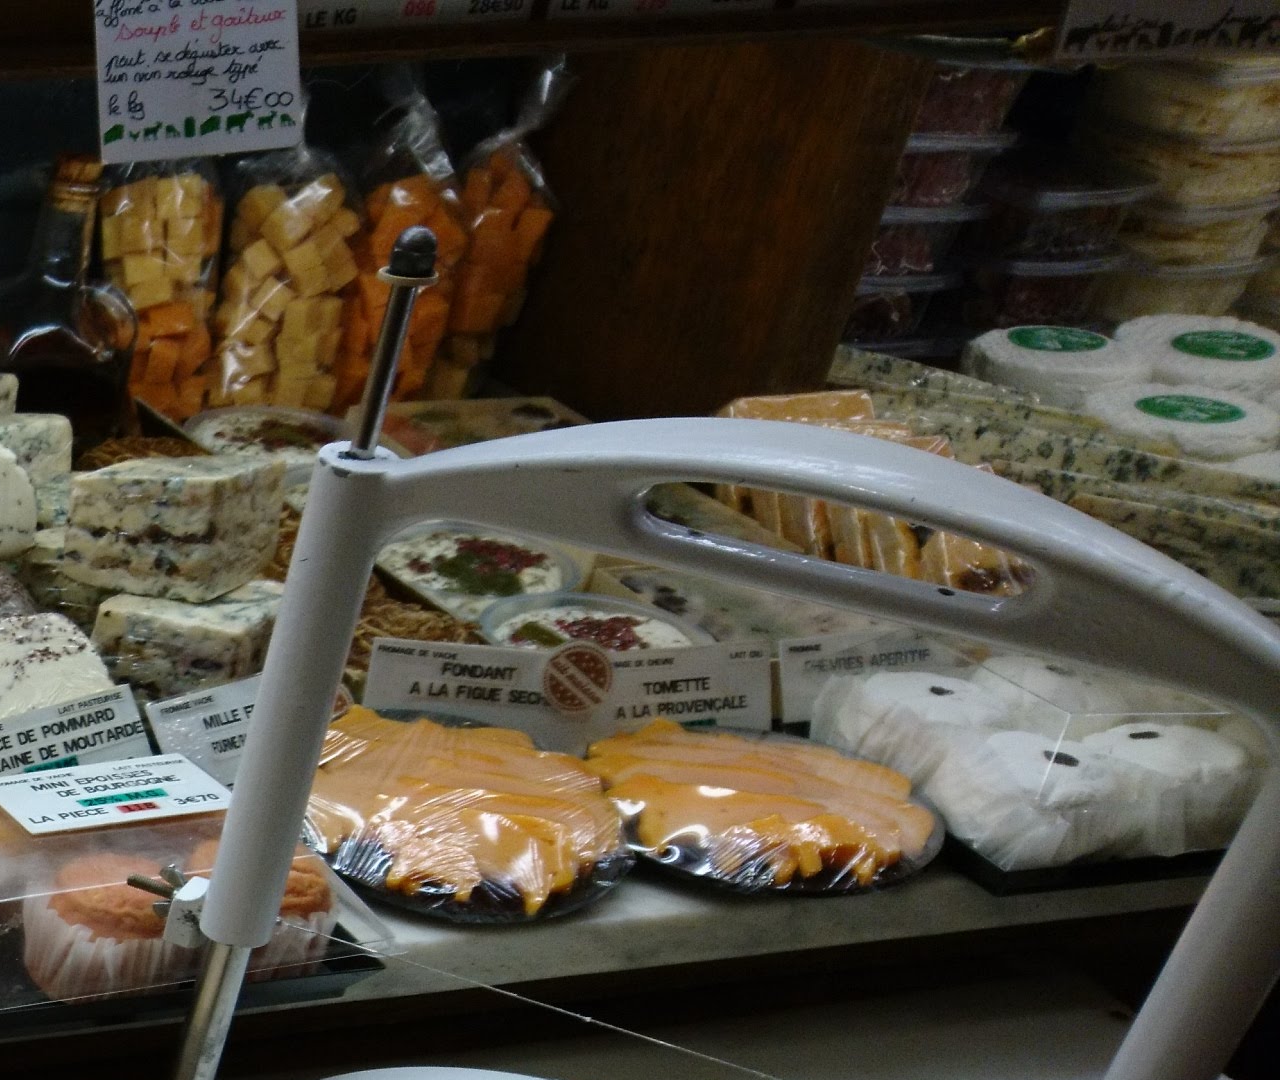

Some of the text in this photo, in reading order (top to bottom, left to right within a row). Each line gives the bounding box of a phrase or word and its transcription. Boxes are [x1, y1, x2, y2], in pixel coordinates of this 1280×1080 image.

[191, 9, 208, 31] et
[305, 8, 357, 28] LE KG
[207, 86, 294, 112] 34€00
[441, 661, 517, 680] FONDANT
[409, 682, 503, 702] A LA FIGUE
[643, 676, 711, 695] TOMETTE
[632, 694, 748, 718] LA PROVENÇALE
[17, 729, 38, 746] DE
[42, 707, 115, 739] POMMARD
[203, 710, 240, 730] MILLE
[39, 744, 58, 761] DE
[63, 720, 145, 753] MOUTARDE
[30, 769, 153, 792] MINI EPOISSES
[56, 774, 181, 798] DE BOURGOGNE
[28, 807, 110, 825] LA PIECE
